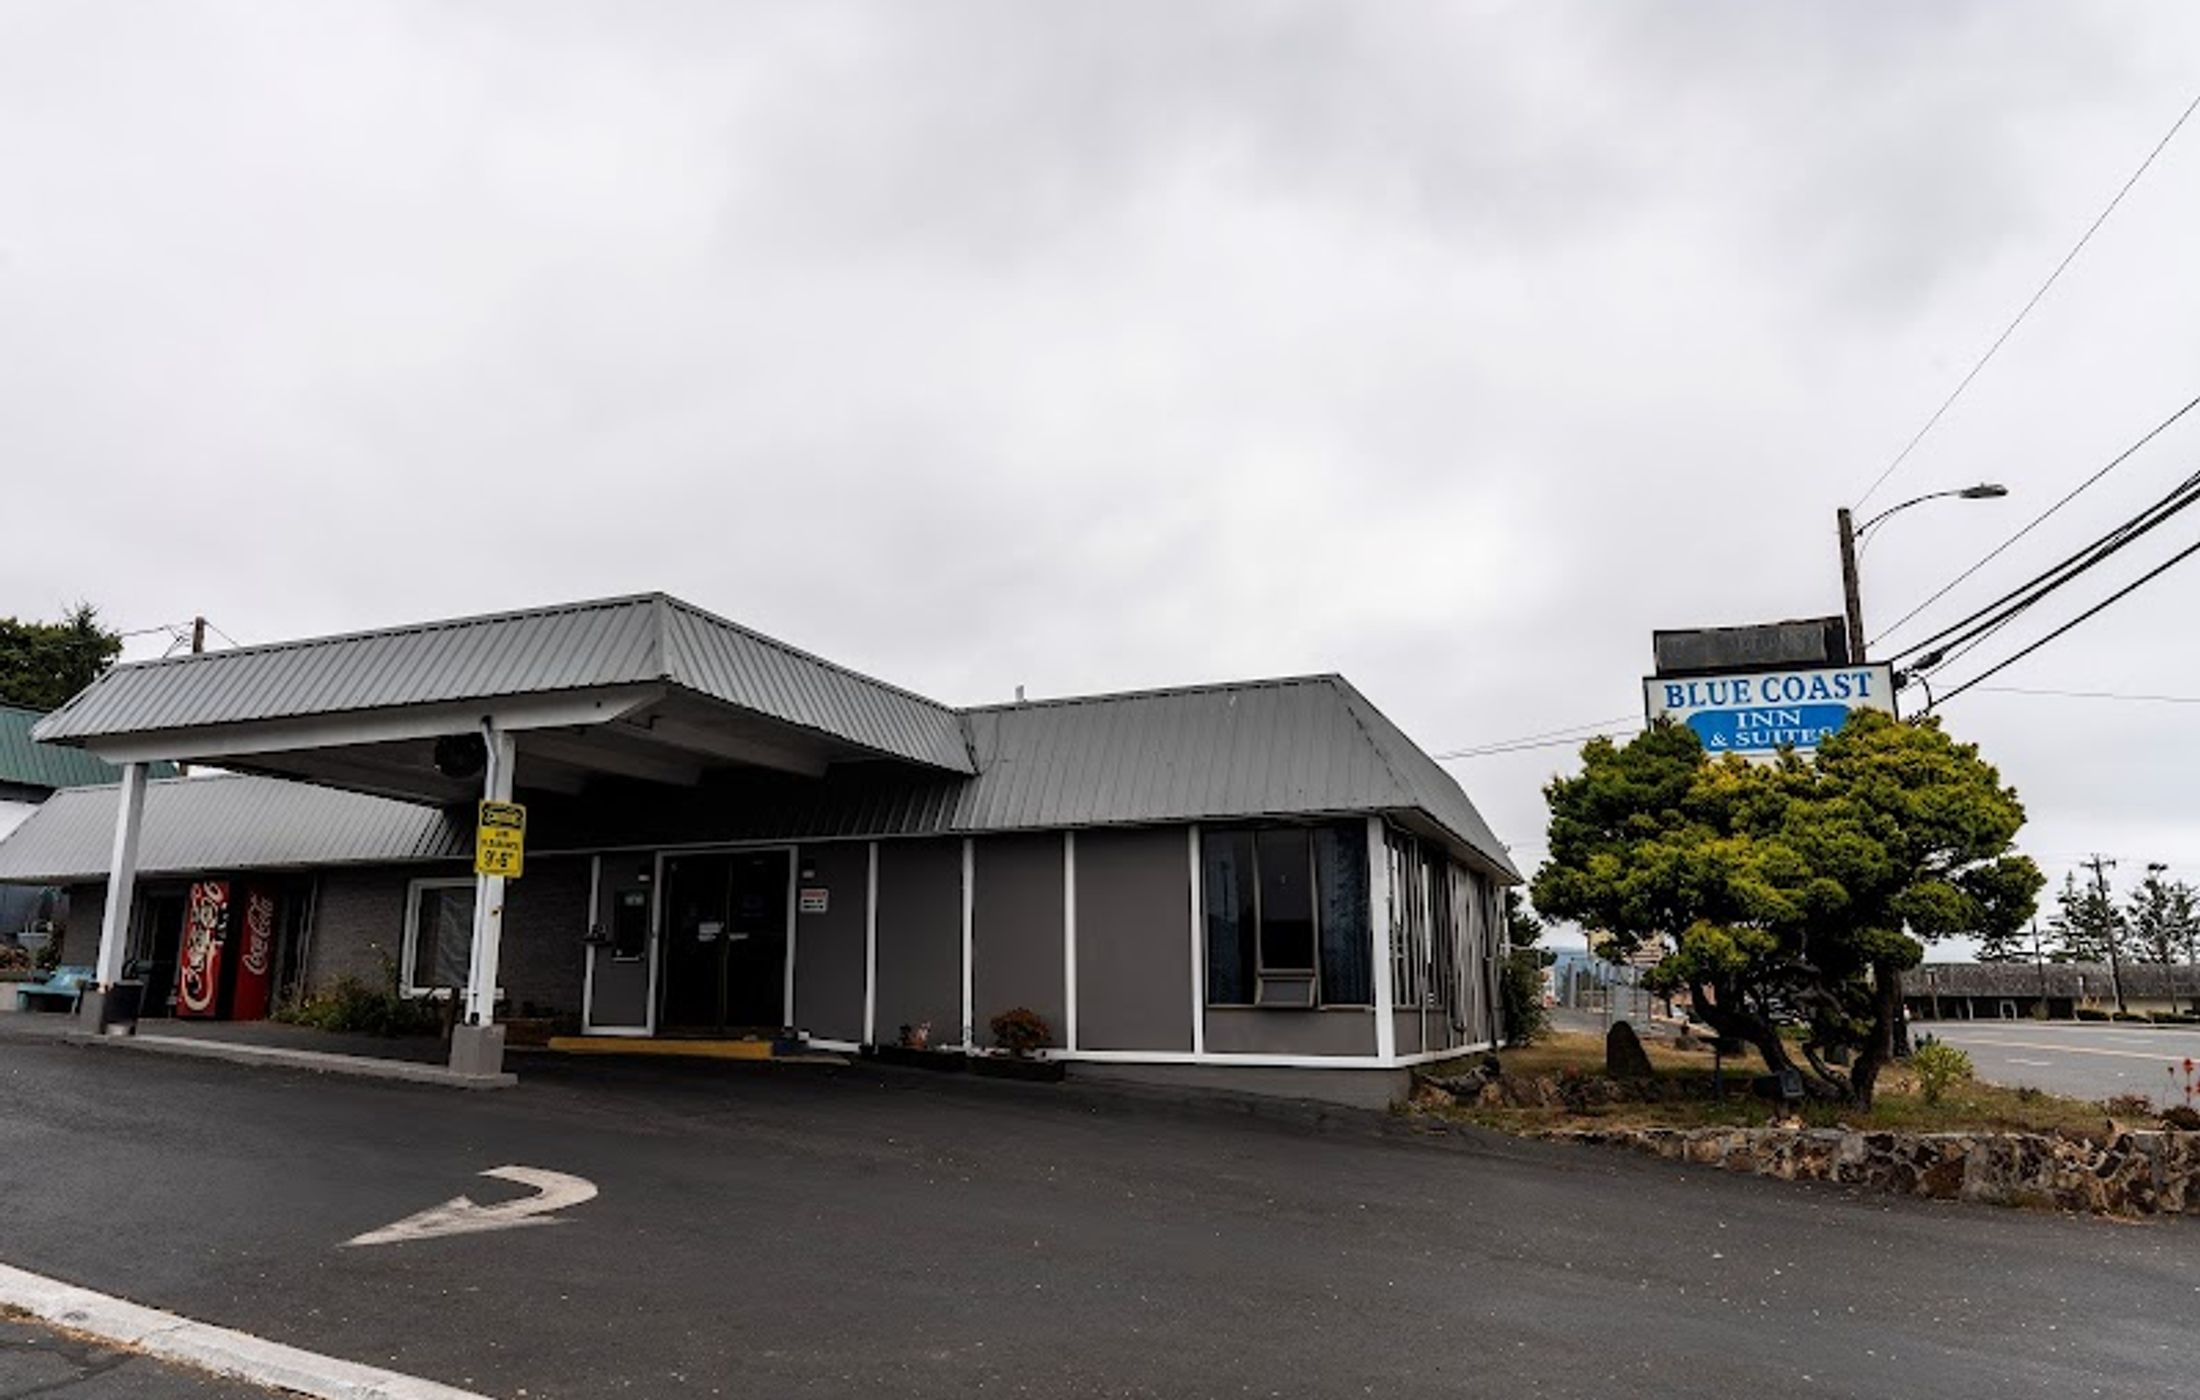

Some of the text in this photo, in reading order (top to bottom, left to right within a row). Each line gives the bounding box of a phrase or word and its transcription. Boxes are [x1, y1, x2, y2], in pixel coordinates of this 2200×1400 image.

[1664, 671, 1873, 708] BLUE COAST
[1736, 709, 1801, 729] INN
[1710, 732, 1728, 747] &
